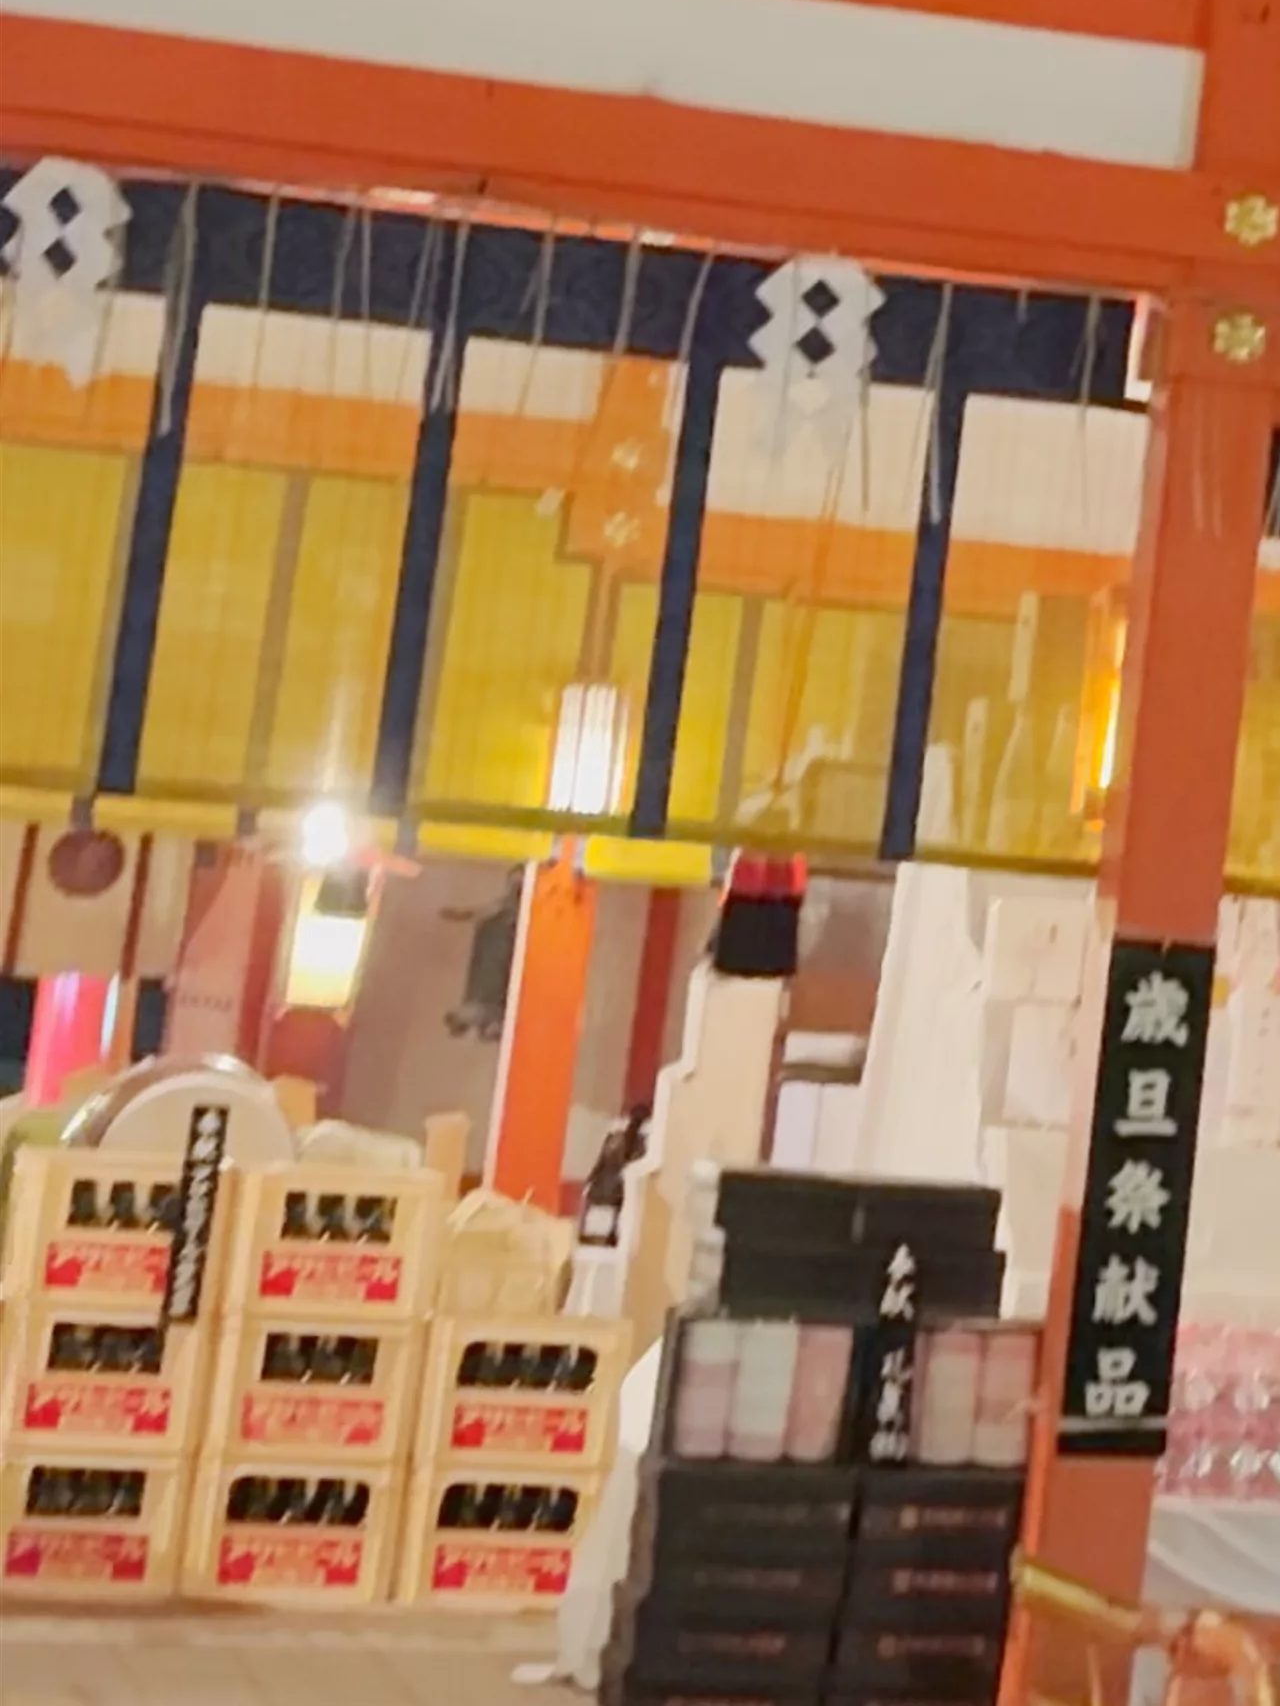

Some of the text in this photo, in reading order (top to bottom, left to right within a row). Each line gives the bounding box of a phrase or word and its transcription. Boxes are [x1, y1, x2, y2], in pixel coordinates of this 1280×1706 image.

[1085, 970, 1191, 1417] 歳旦祭献品
